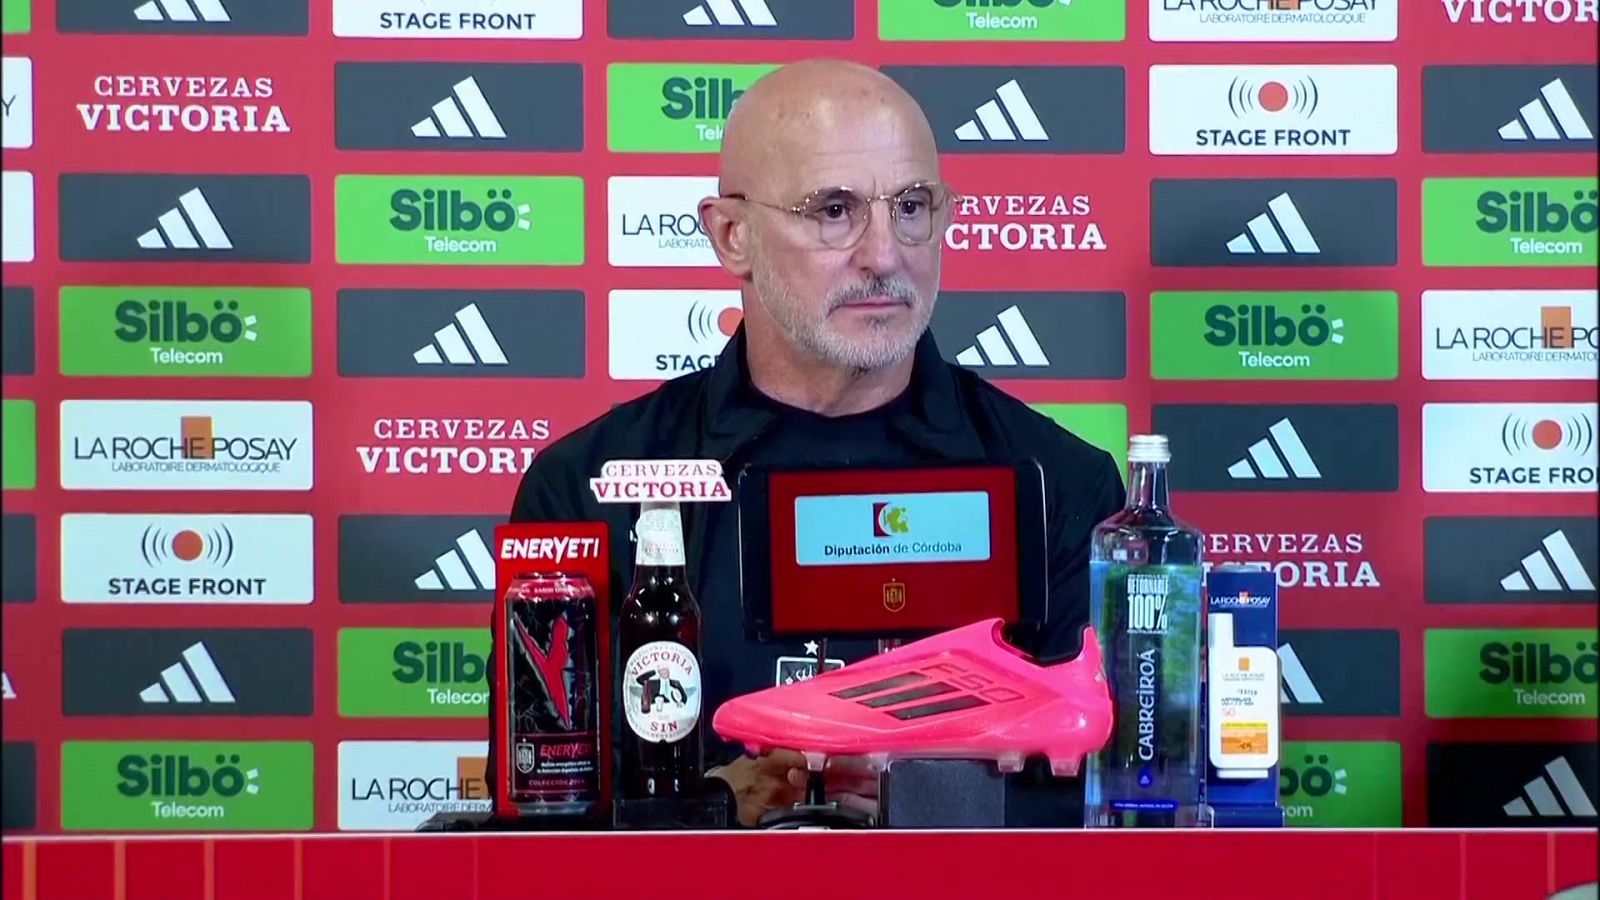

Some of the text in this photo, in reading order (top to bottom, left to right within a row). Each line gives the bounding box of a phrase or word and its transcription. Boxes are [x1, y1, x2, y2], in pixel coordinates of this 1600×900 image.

[380, 12, 536, 30] STAGE FRONT
[966, 12, 1038, 29] Telecom
[1200, 13, 1366, 24] LABORATOIRE DERMATOLOGIQUE
[1441, 0, 1598, 23] VICTOR
[94, 75, 273, 98] CERVEZAS
[76, 104, 291, 132] VICTORIA
[1196, 129, 1351, 146] STAGE FRONT
[389, 188, 516, 232] Silbö
[957, 195, 1091, 216] RVEZAS
[1476, 190, 1598, 233] Silbö
[622, 214, 654, 236] LA
[424, 236, 497, 252] Telecom
[944, 223, 1107, 250] CTORIA
[1509, 237, 1583, 254] Telecom
[114, 299, 243, 343] Silbö
[1203, 303, 1330, 347] Silbö
[1436, 327, 1469, 349] LA
[1473, 327, 1565, 349] ROCHE
[150, 348, 223, 364] Telecom
[1238, 351, 1310, 368] Telecom
[1472, 351, 1543, 362] LABORATOIRE
[374, 418, 550, 440] CERVEZAS
[74, 436, 298, 460] LA ROCHE POSAY
[112, 462, 281, 473] LABORATOIRE DERMATOLOGIQUE
[356, 447, 535, 473] VICTORI
[606, 464, 717, 477] CERVEZAS
[1469, 467, 1598, 483] STAGE FRO
[595, 481, 728, 498] VICTORIA
[500, 536, 600, 564] ENERYETI
[824, 541, 962, 558] Diputación de Córdoba
[1203, 534, 1363, 553] ERVEZAS
[108, 577, 267, 595] STAGE FRONT
[1127, 594, 1168, 630] 100%
[392, 641, 486, 684] Silb
[630, 651, 694, 676] VICTORIA
[1513, 688, 1586, 705] Telecom
[650, 721, 678, 732] SIN
[116, 753, 245, 797] Silbö
[352, 778, 481, 800] LA ROCHE
[151, 801, 225, 818] Telecom
